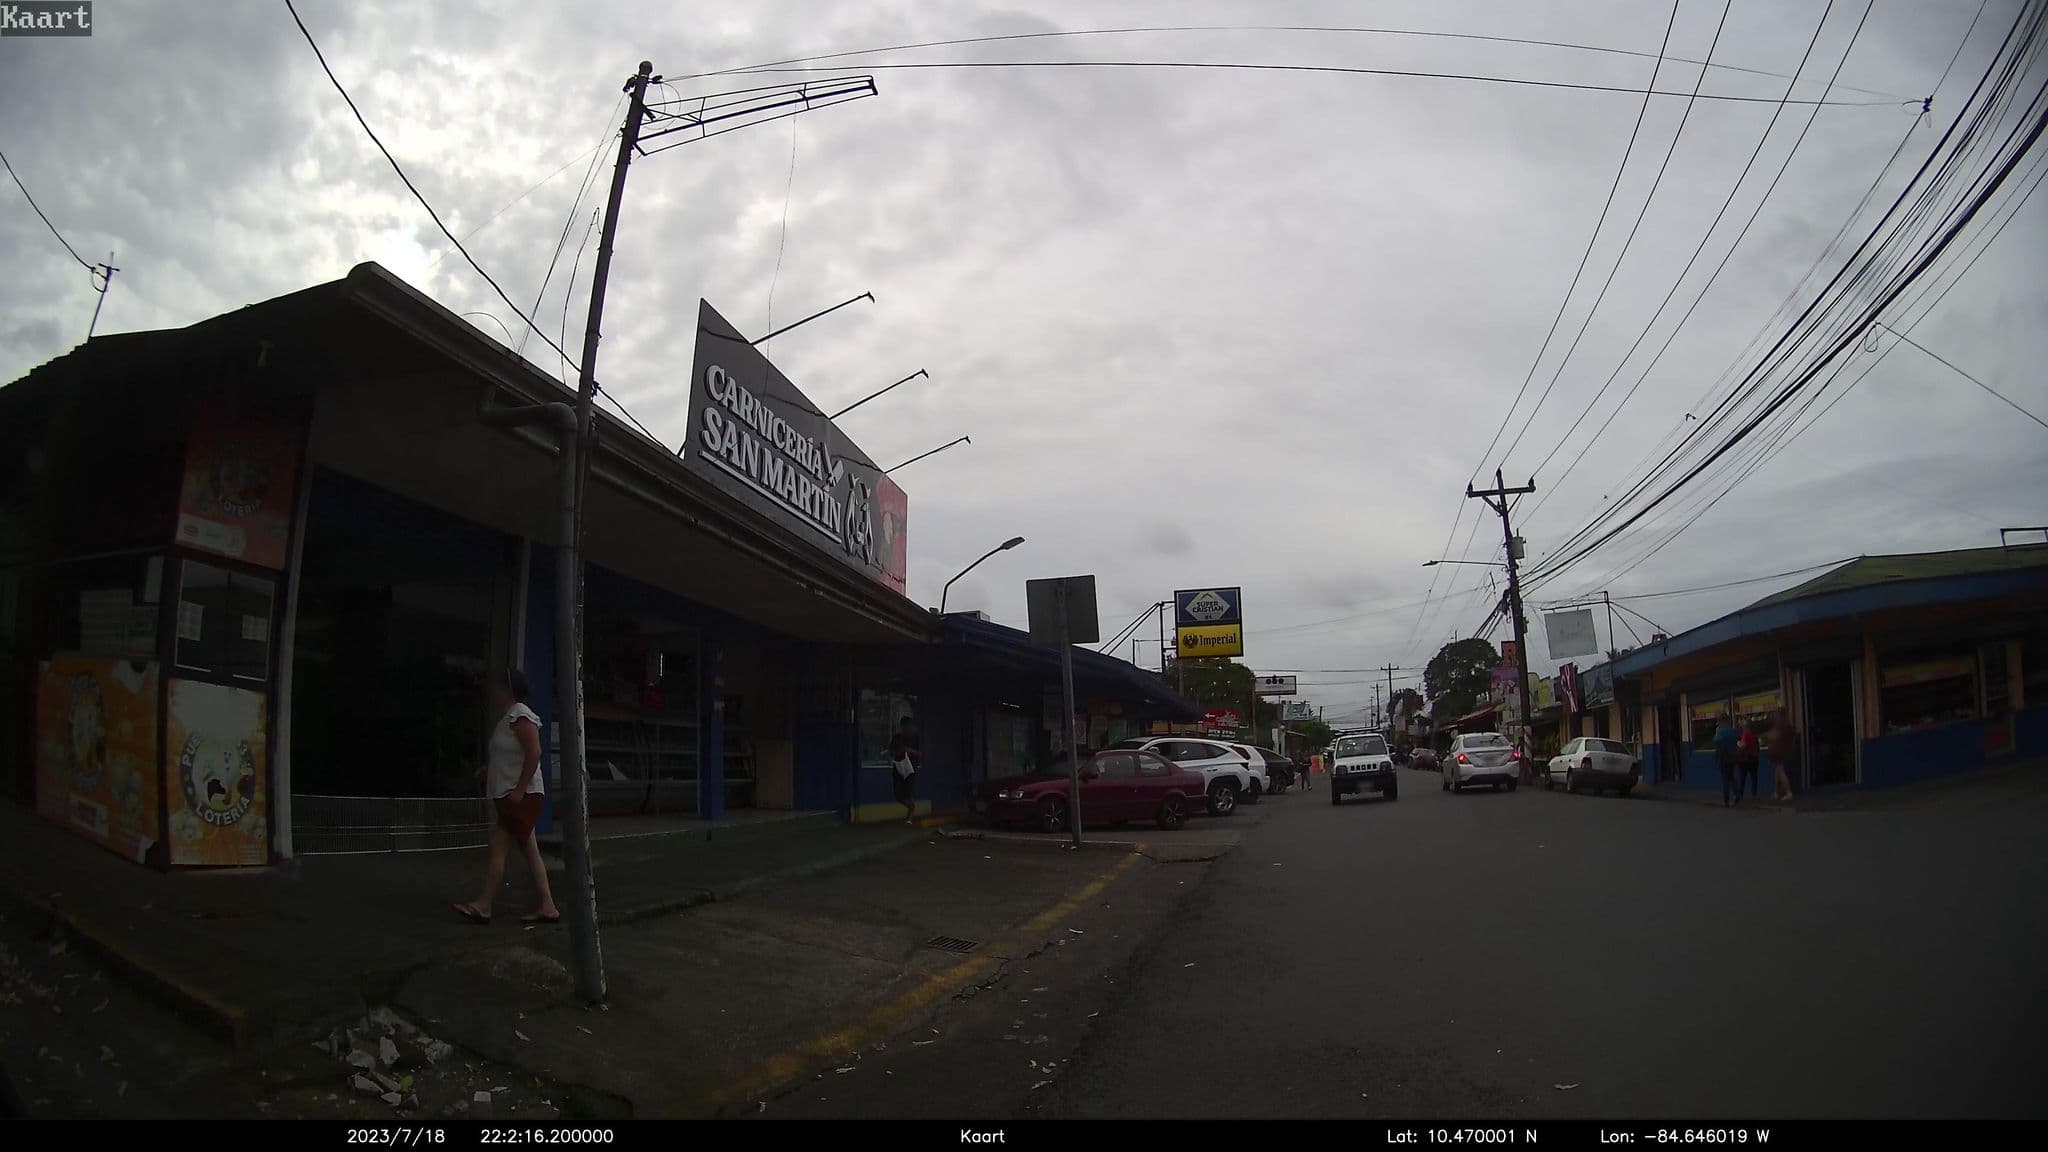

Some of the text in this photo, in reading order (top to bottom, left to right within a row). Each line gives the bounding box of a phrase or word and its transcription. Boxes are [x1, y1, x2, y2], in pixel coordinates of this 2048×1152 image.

[704, 364, 824, 482] CARNICERÍA
[701, 405, 842, 533] SAN MARTÍN
[1192, 605, 1224, 613] CRISTIAN
[1199, 633, 1236, 647] Imperial
[195, 796, 250, 826] LOTERIA
